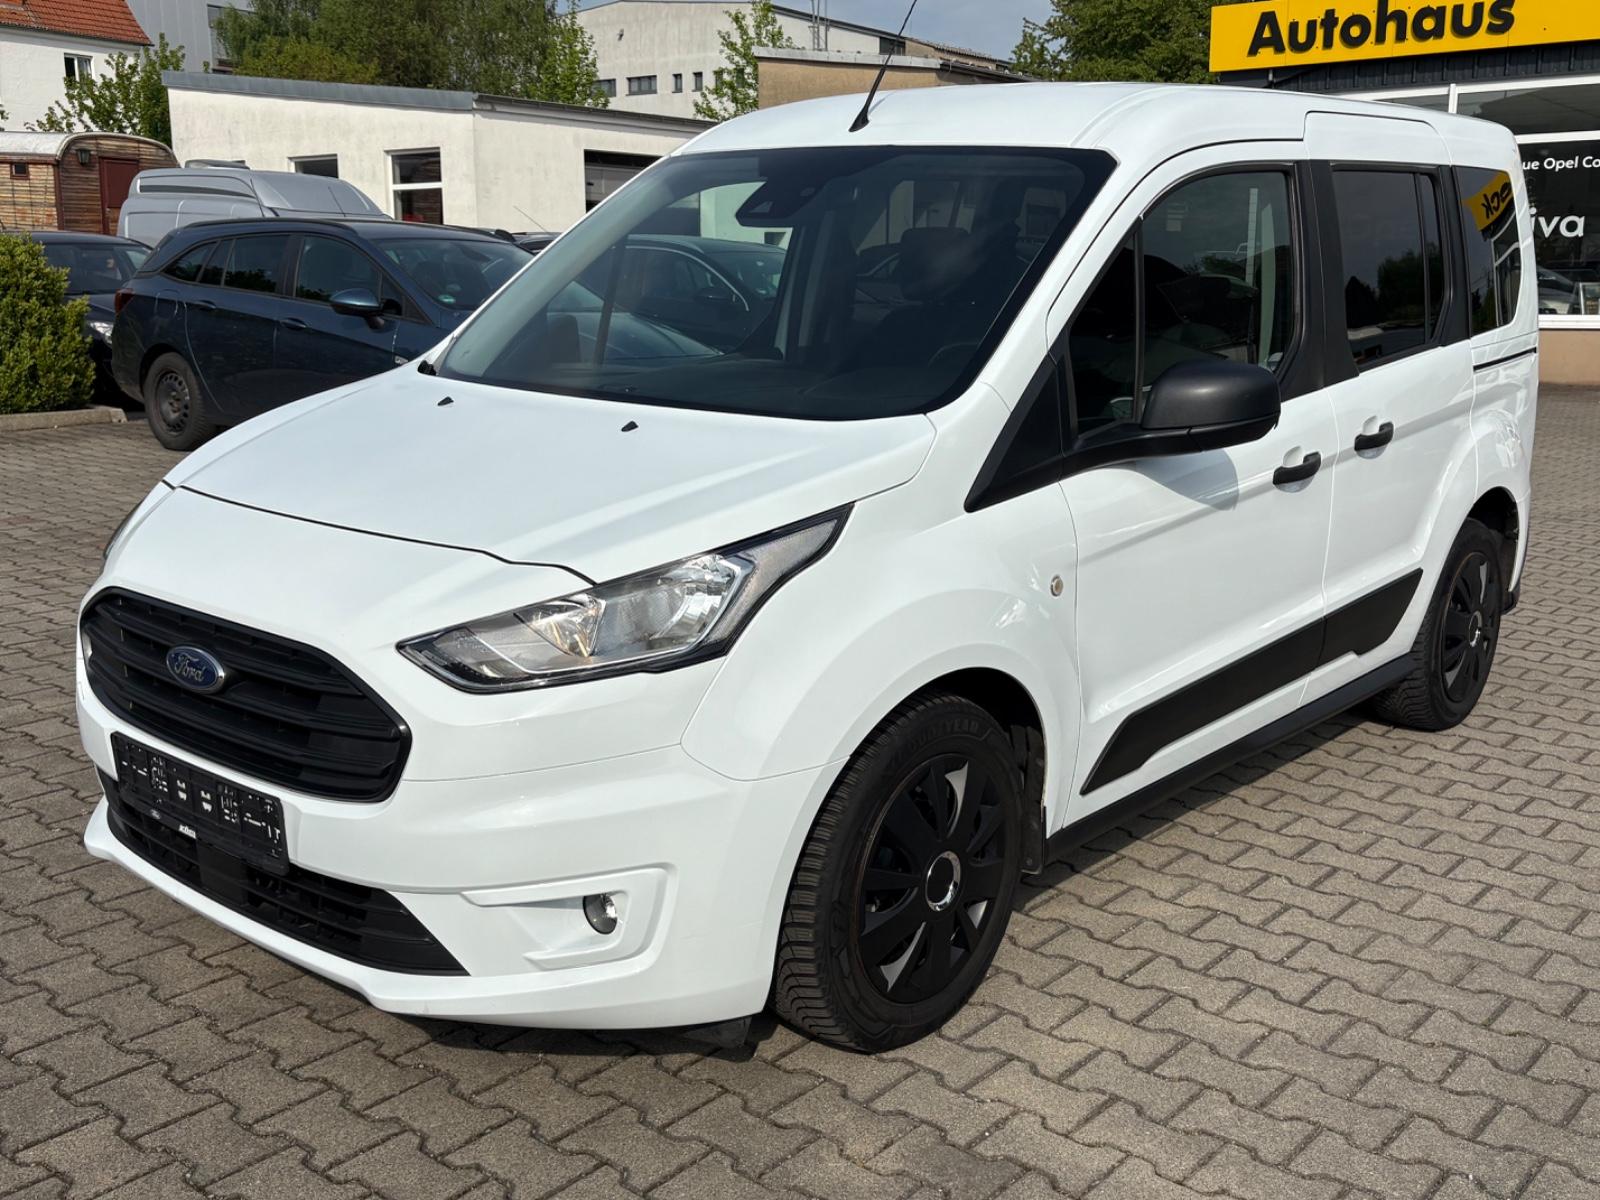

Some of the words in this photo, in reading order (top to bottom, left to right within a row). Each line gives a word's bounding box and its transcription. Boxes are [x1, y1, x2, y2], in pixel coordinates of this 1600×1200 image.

[1247, 0, 1515, 56] Autohaus
[1543, 155, 1579, 172] Opel
[174, 652, 206, 682] Ford
